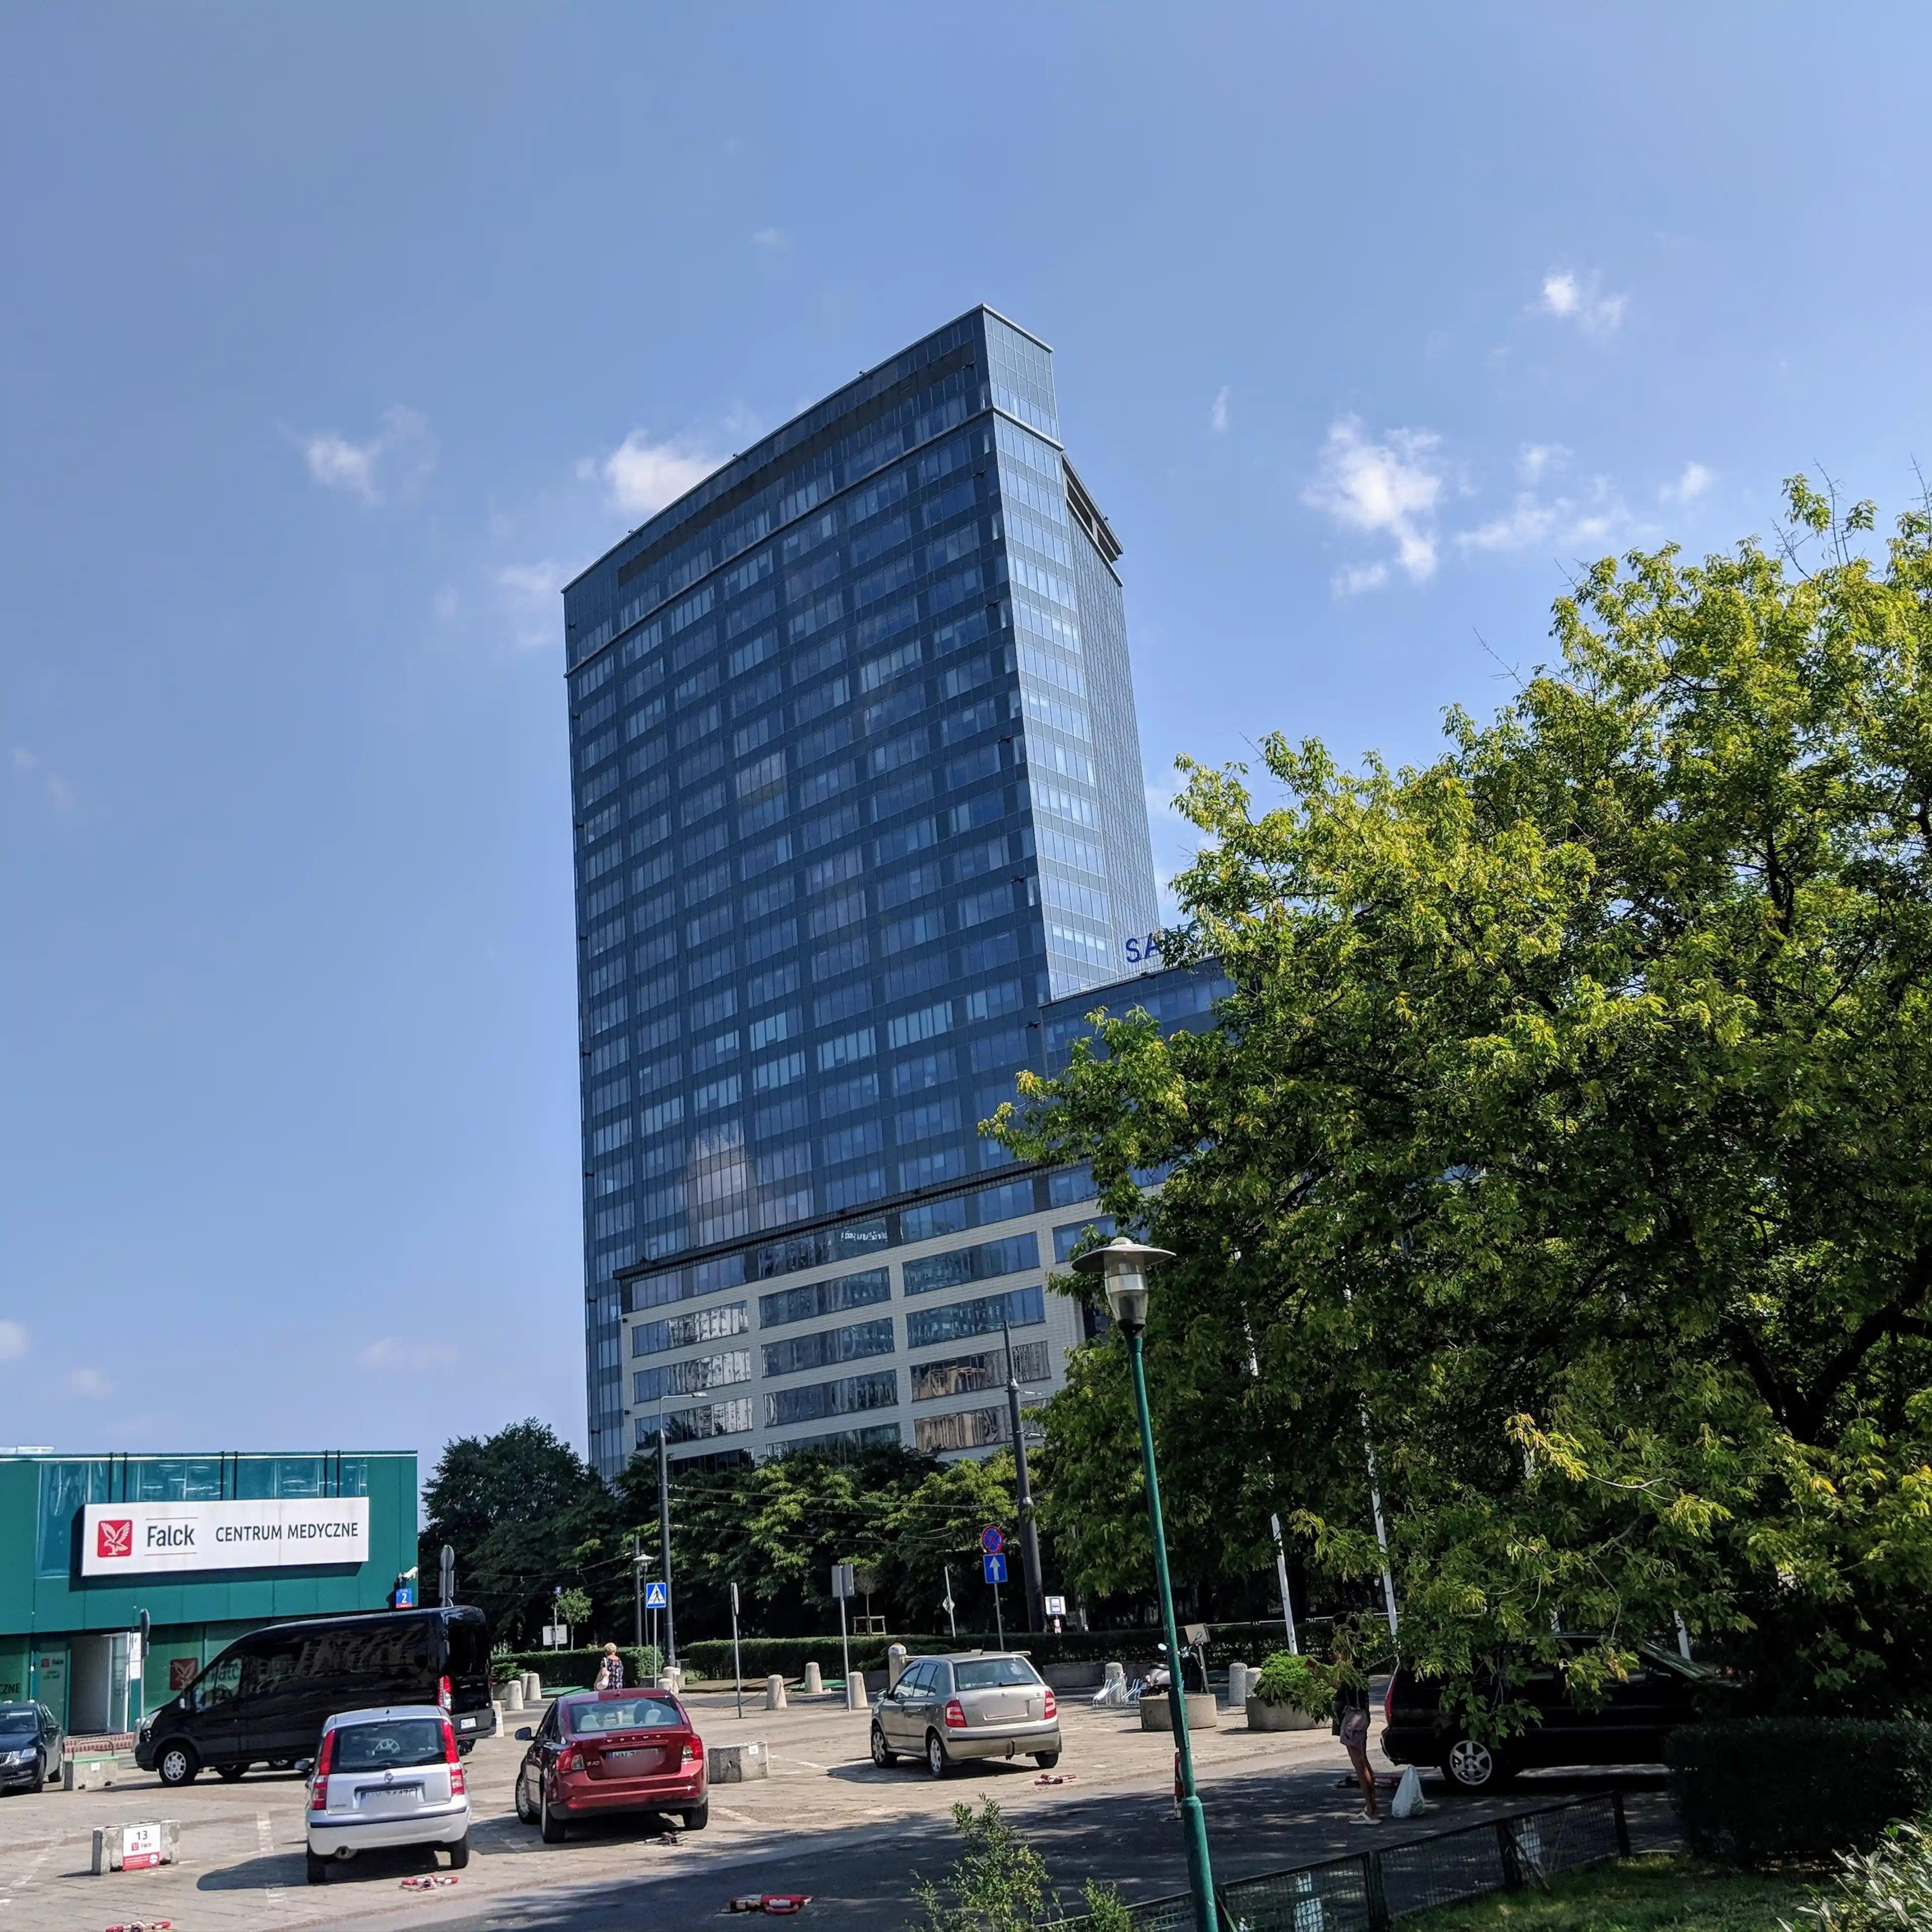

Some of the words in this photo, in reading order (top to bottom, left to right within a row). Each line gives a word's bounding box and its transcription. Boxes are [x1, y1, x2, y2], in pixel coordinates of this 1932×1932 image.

[146, 1524, 195, 1547] Falck
[216, 1525, 282, 1543] CENTRUM
[288, 1522, 358, 1540] MEDYCZNE
[401, 1593, 407, 1603] 2
[136, 1830, 148, 1840] 13
